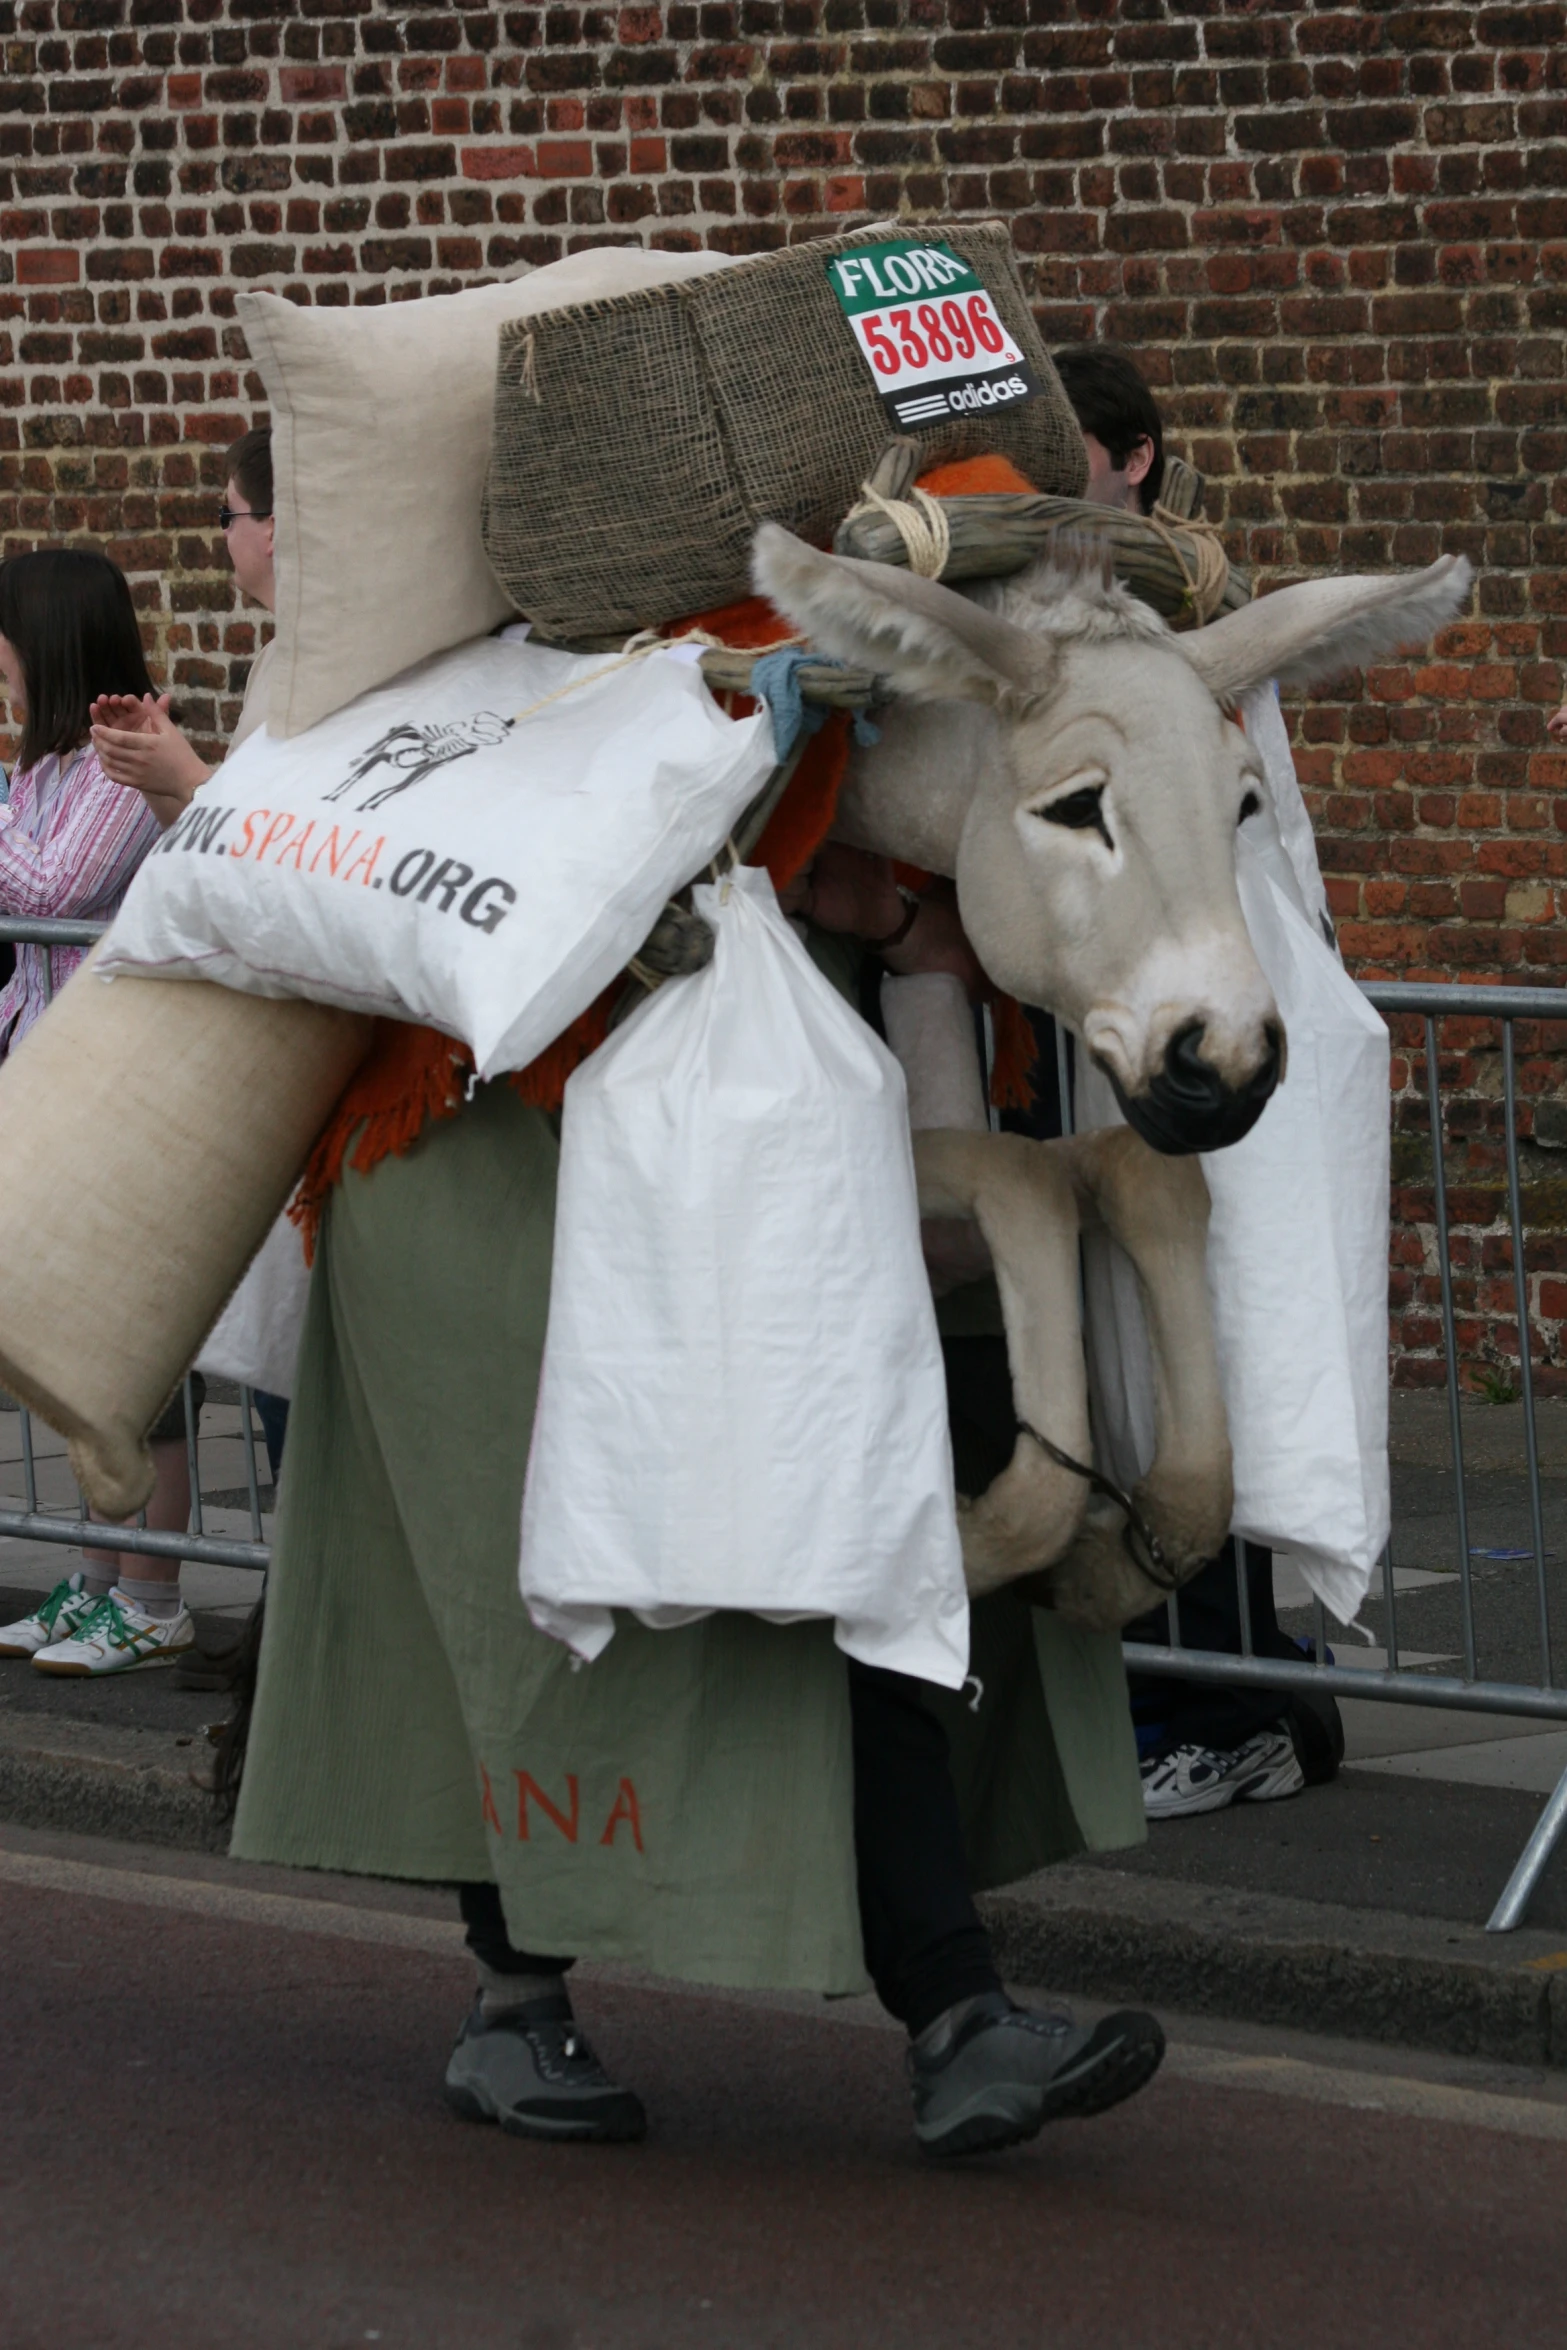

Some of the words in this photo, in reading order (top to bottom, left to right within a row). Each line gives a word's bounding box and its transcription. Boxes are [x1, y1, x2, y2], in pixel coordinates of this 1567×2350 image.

[834, 249, 969, 297] FLORA
[861, 295, 1004, 375] 53896
[1005, 352, 1016, 363] 9
[949, 376, 1028, 411] adidas
